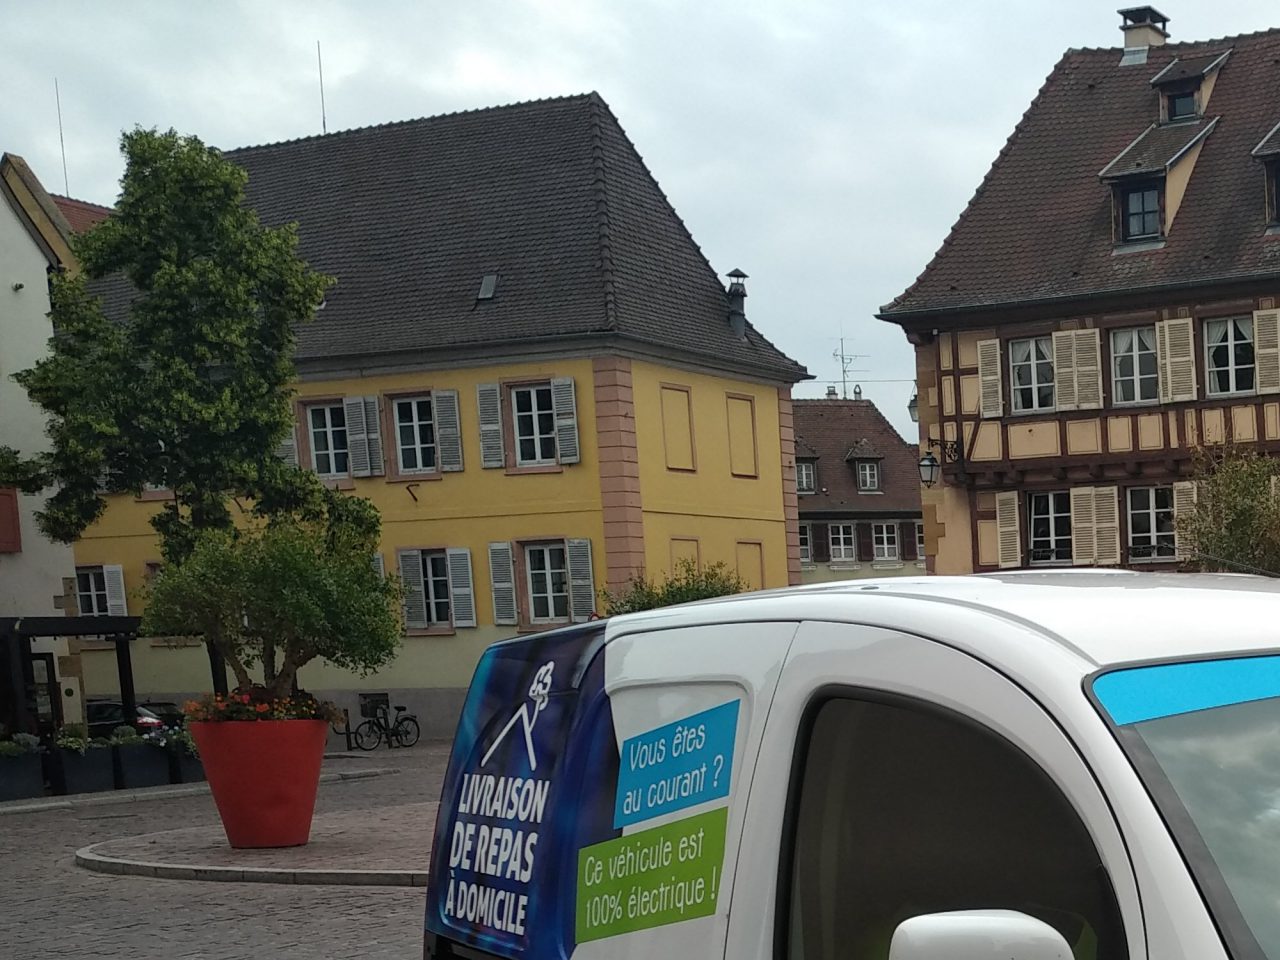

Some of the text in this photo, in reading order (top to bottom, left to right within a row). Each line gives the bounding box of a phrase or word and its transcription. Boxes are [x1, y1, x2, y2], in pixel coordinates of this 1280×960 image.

[629, 723, 706, 772] Vous êtes
[458, 773, 550, 823] LIVRAISON
[622, 755, 724, 815] au courant ?
[449, 820, 538, 883] DE REPAS
[585, 828, 704, 887] Ce véhicule est
[444, 871, 528, 936] À DOMICILE
[586, 891, 623, 929] 100%
[627, 876, 705, 919] électrique
